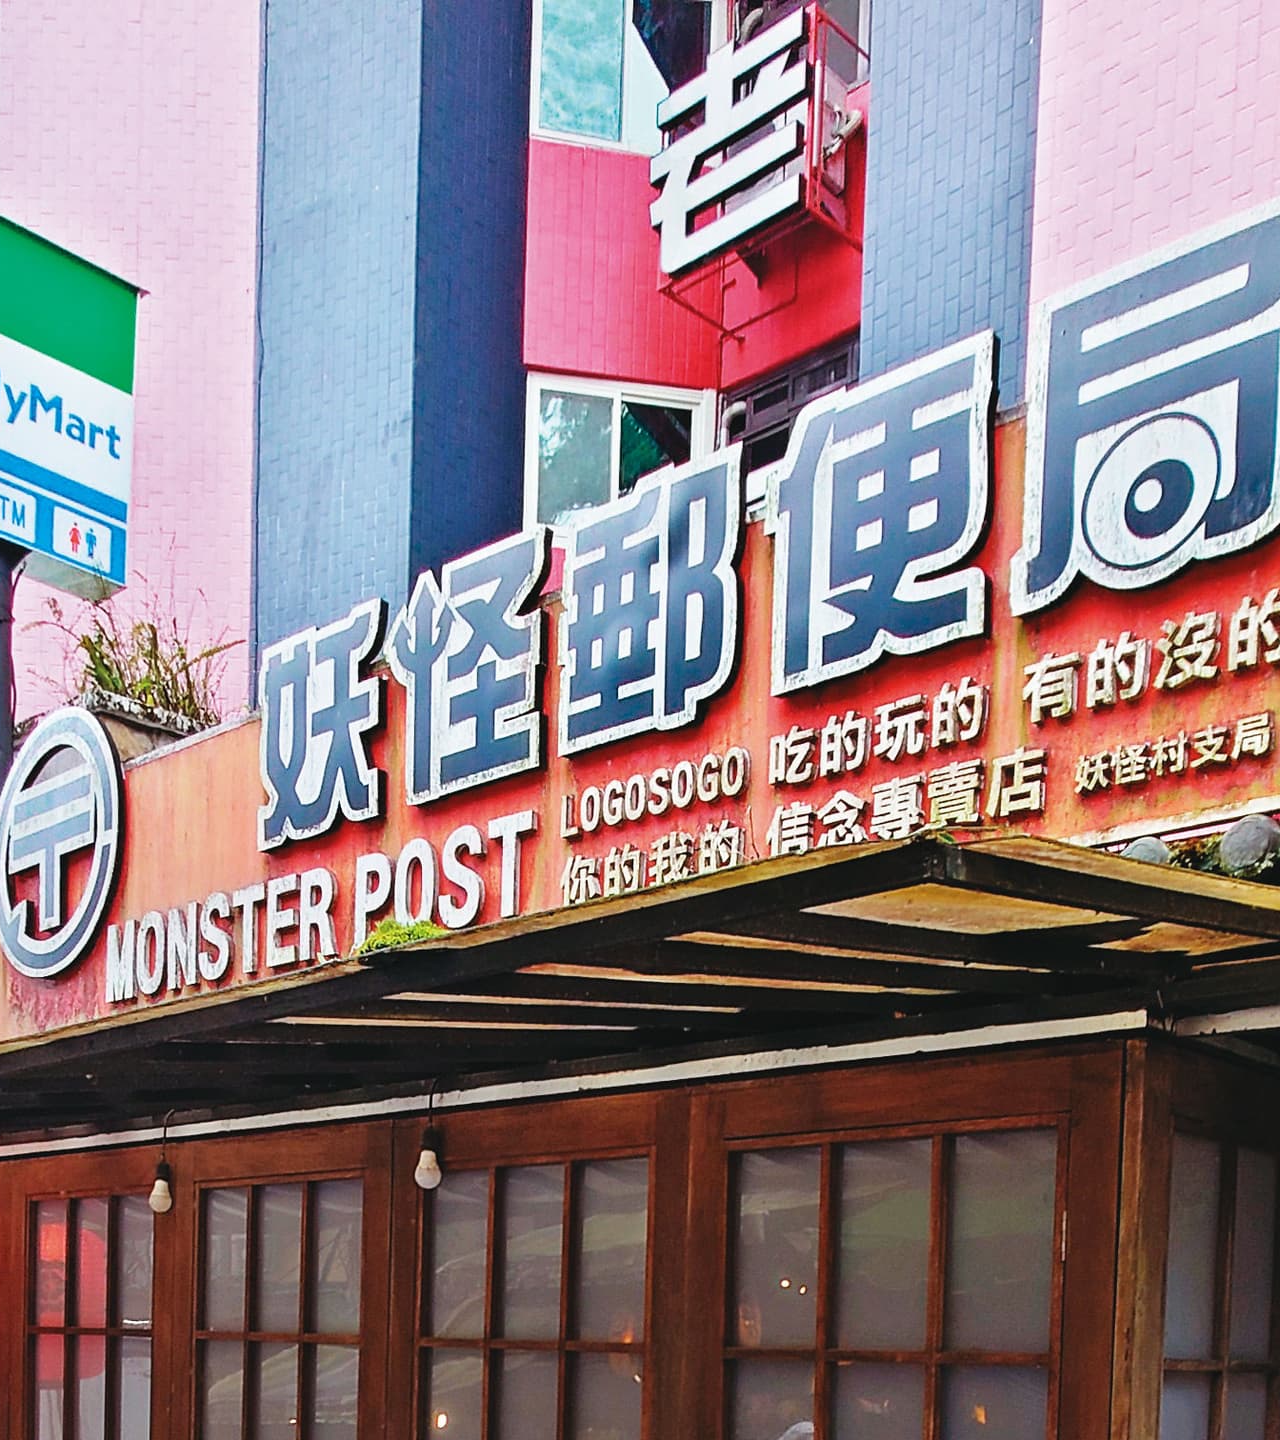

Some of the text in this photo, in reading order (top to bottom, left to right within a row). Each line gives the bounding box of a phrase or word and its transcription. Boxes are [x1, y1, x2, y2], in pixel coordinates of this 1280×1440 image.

[560, 747, 748, 839] LOGOSOGO
[769, 676, 988, 785] 吃的玩的
[560, 819, 744, 906] 你的我的
[1074, 711, 1276, 795] 妖怪村支局
[106, 809, 538, 1003] MONSTER POST
